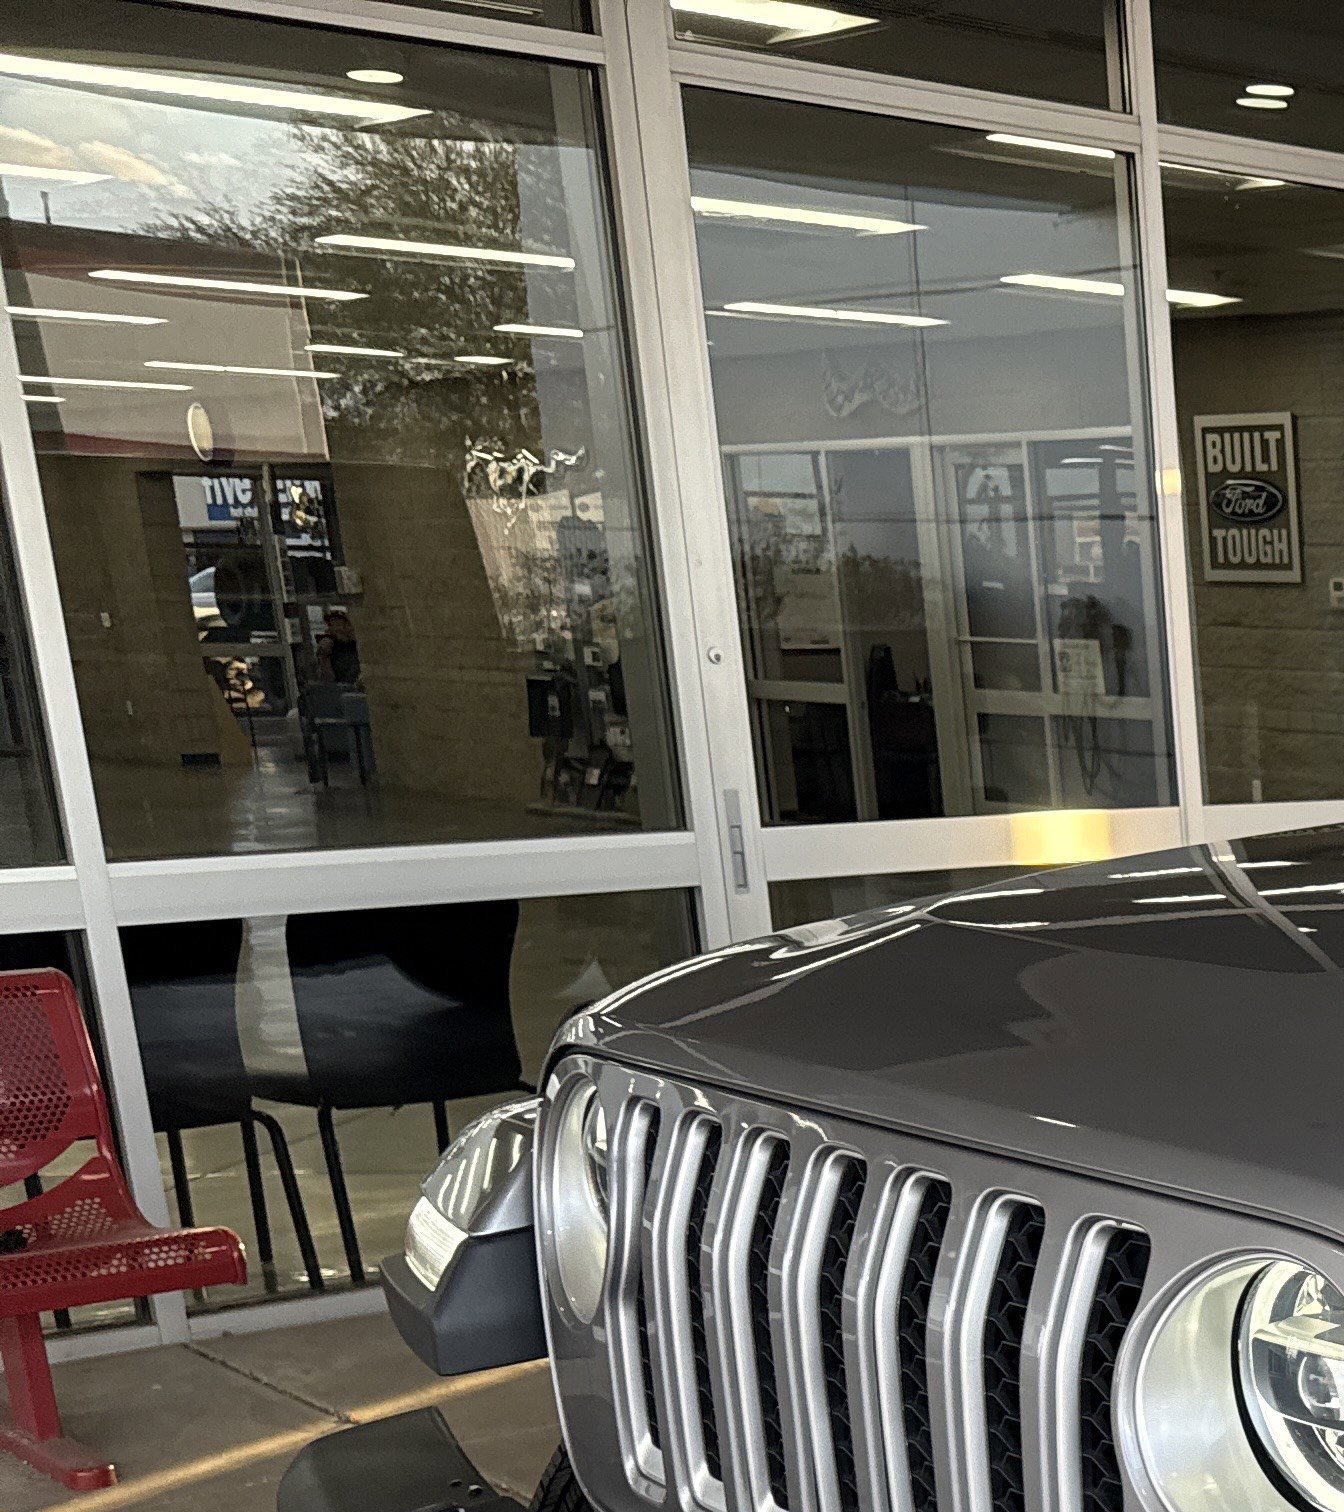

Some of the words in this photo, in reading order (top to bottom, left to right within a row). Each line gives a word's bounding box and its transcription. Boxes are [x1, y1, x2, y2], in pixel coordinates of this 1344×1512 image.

[1205, 431, 1282, 473] BUILT
[1221, 486, 1268, 514] Ford
[1212, 528, 1290, 565] TOUGH
